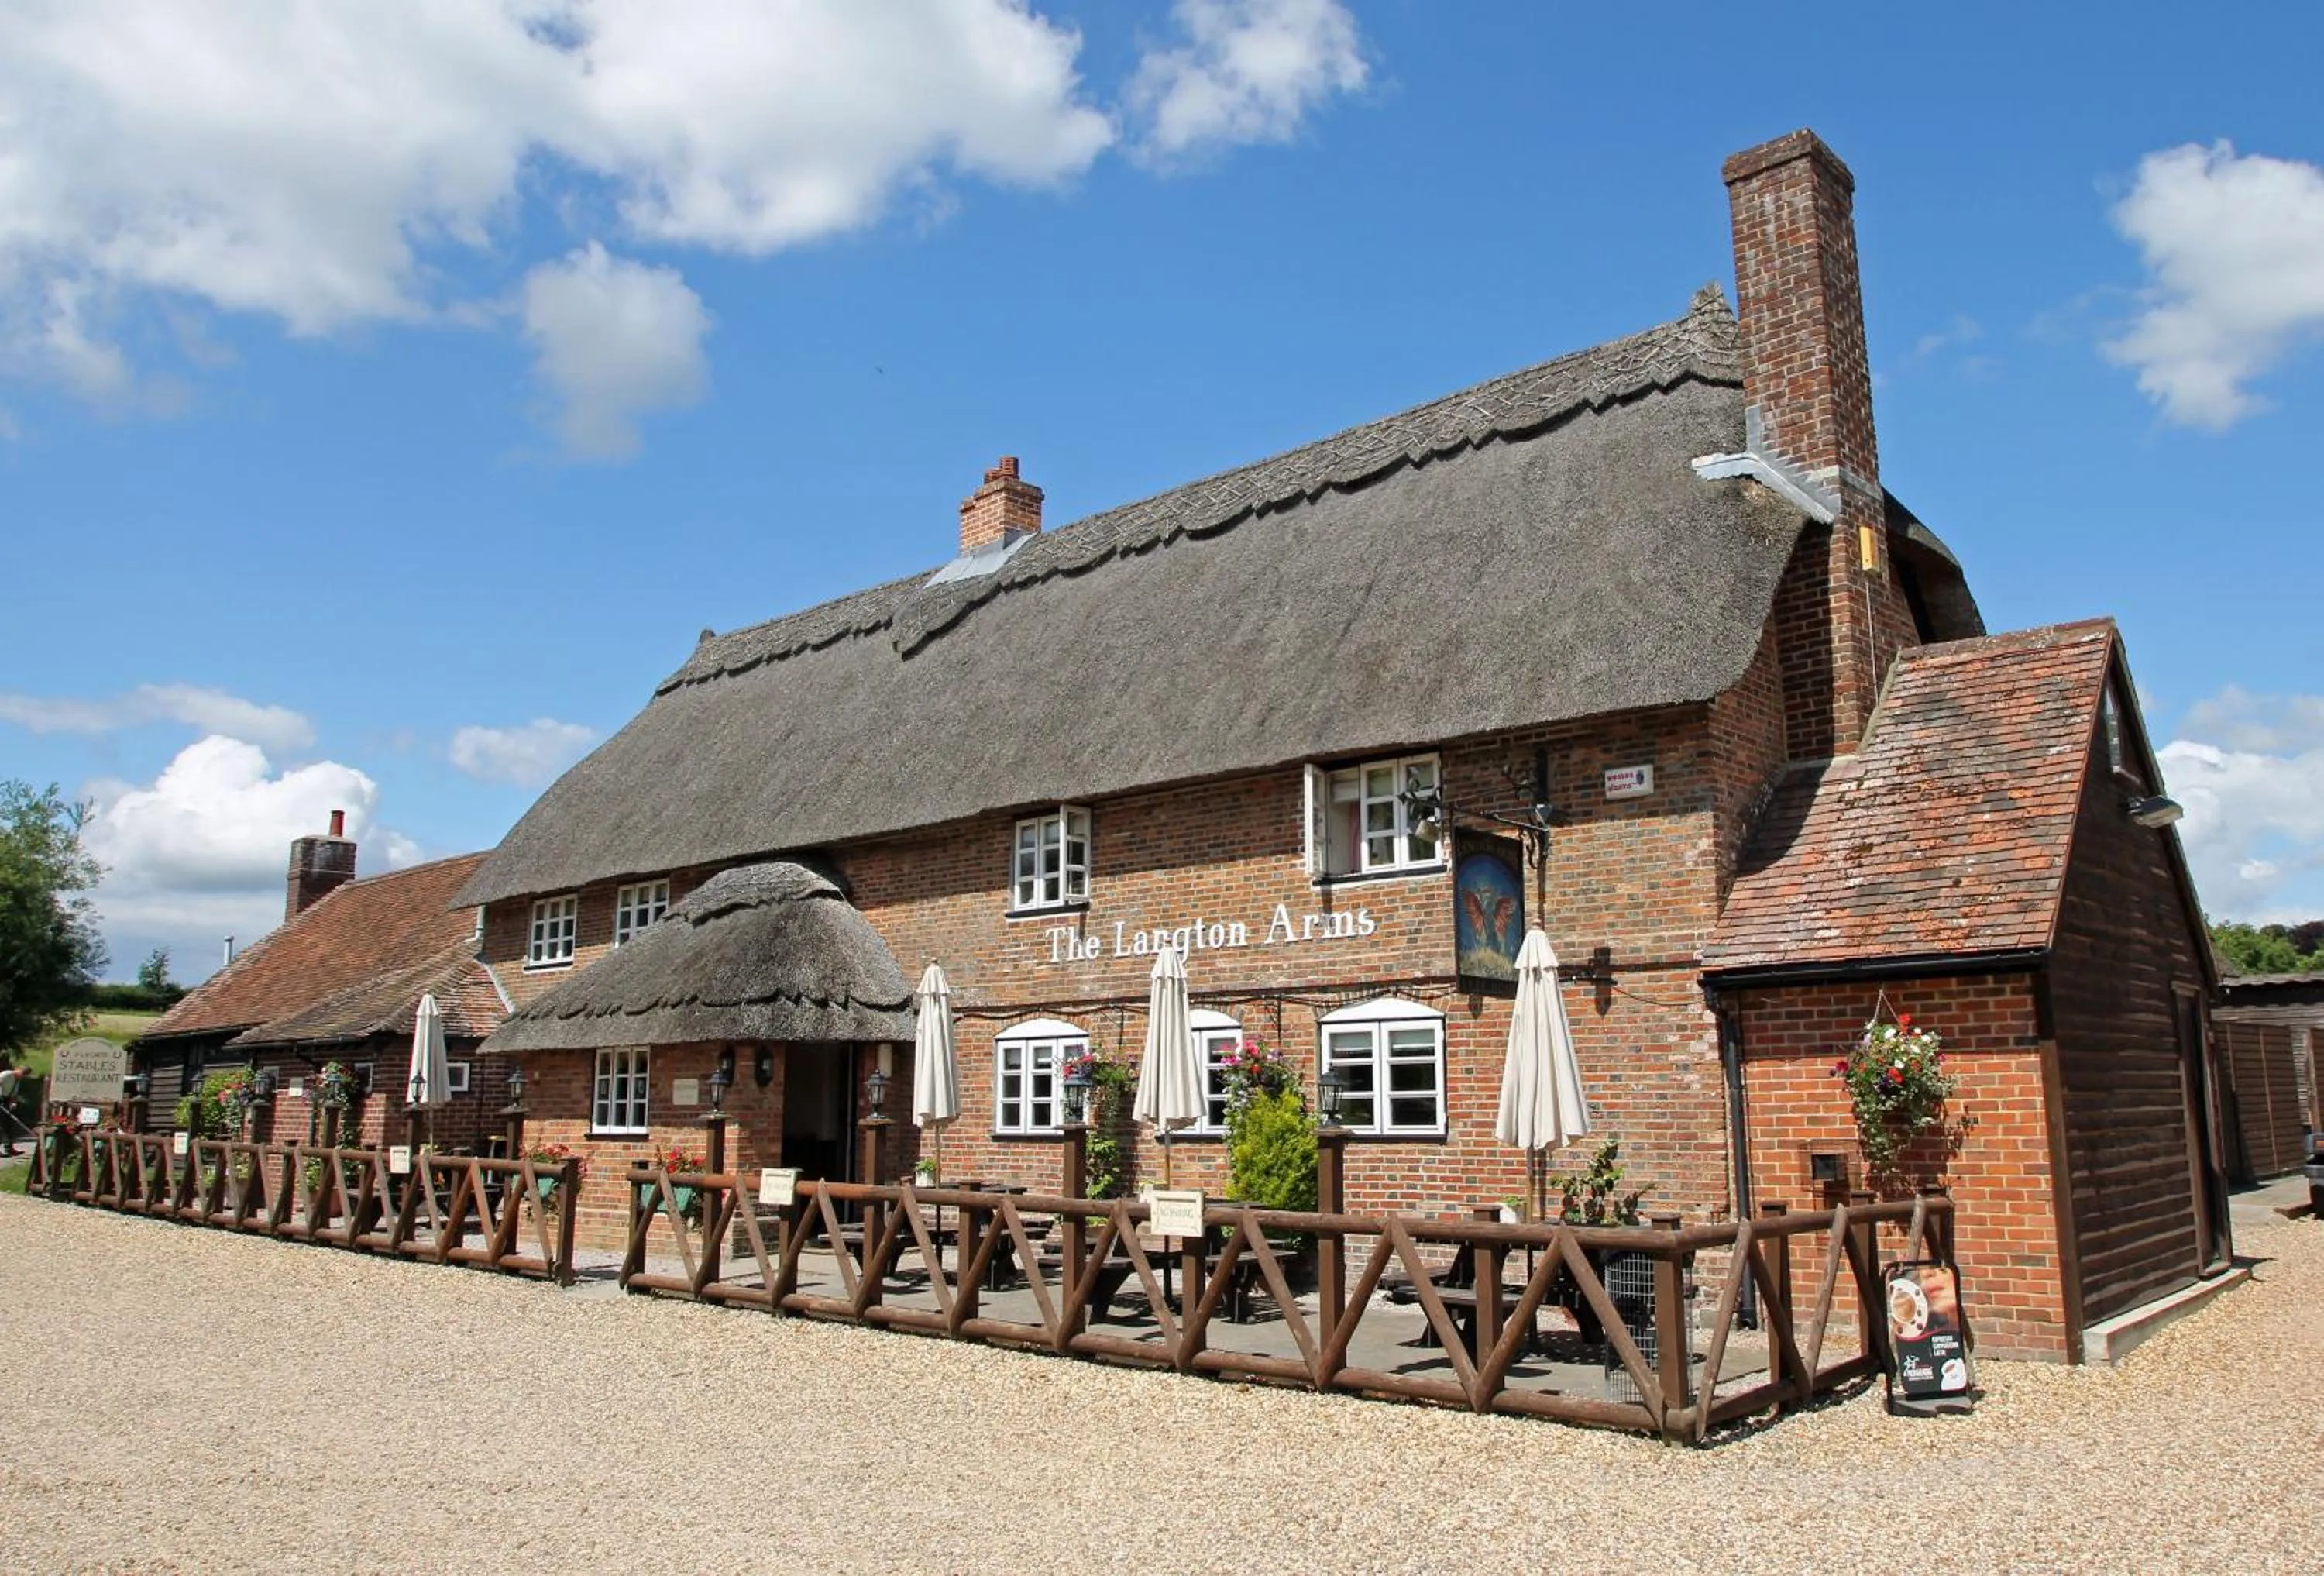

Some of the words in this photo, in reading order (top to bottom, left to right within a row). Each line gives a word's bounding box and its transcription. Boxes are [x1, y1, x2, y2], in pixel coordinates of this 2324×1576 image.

[1046, 927, 1101, 962] The
[1113, 917, 1247, 963] Langton
[1264, 903, 1375, 944] Arms
[59, 1059, 116, 1071] STABLES
[55, 1073, 122, 1083] RESTAURANT
